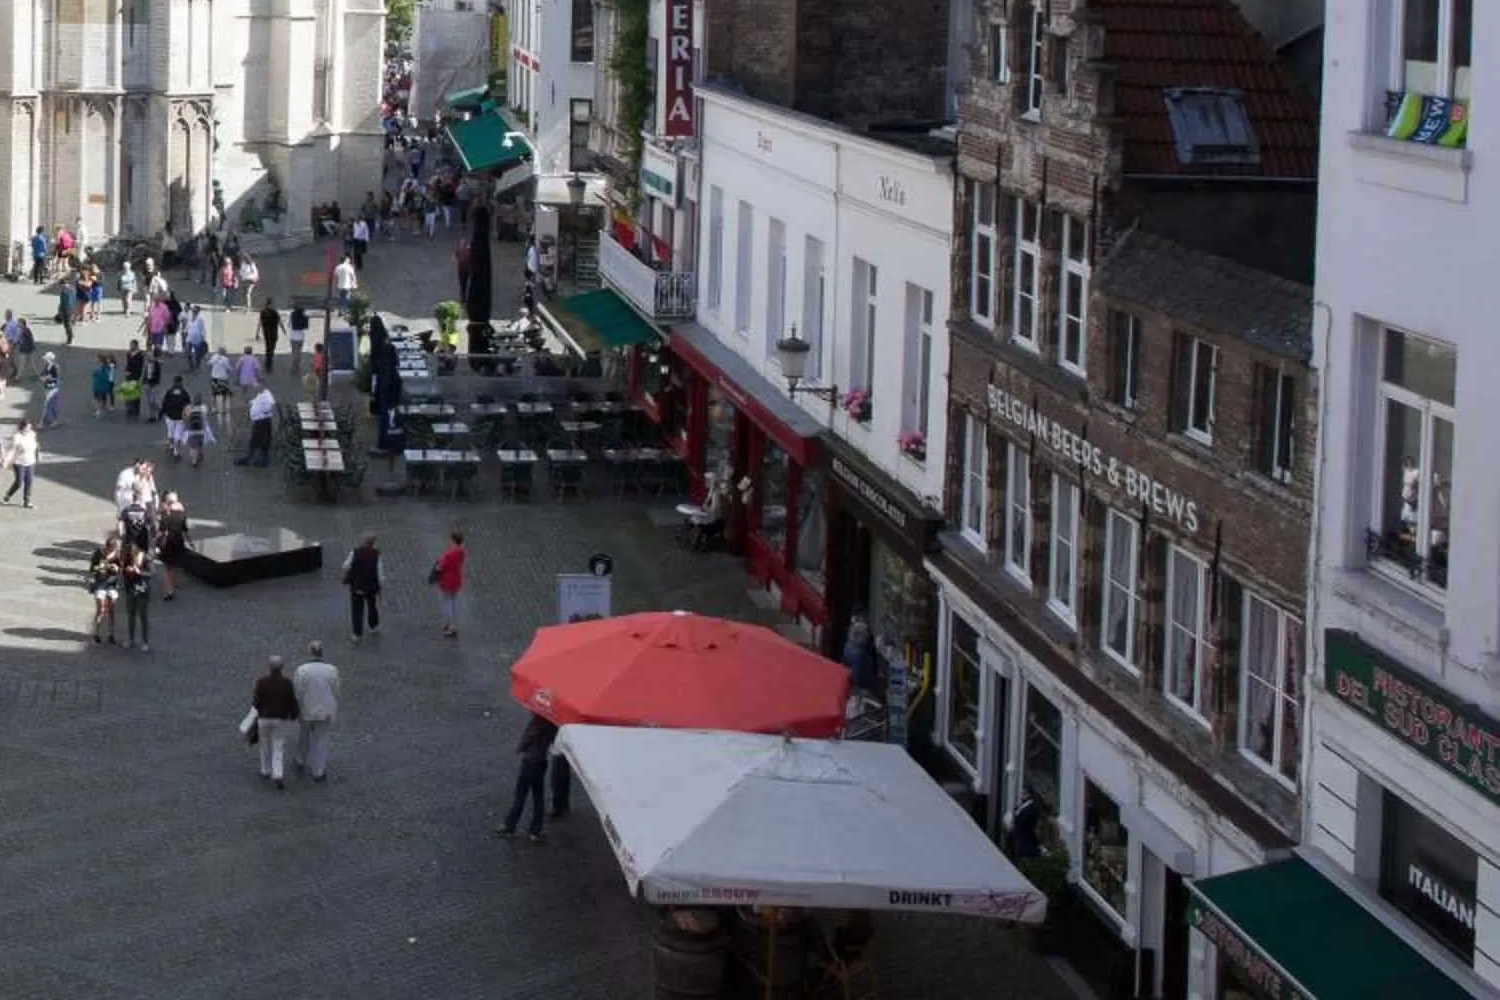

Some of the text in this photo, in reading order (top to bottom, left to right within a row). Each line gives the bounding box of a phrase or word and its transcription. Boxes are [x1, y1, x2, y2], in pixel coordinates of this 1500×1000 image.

[987, 384, 1199, 533] BELGIAN BEERS & BREWS
[1334, 669, 1377, 716] DEL
[1383, 701, 1430, 747] SUD
[888, 890, 953, 907] DRINKT
[1408, 863, 1474, 929] ITALIAN
